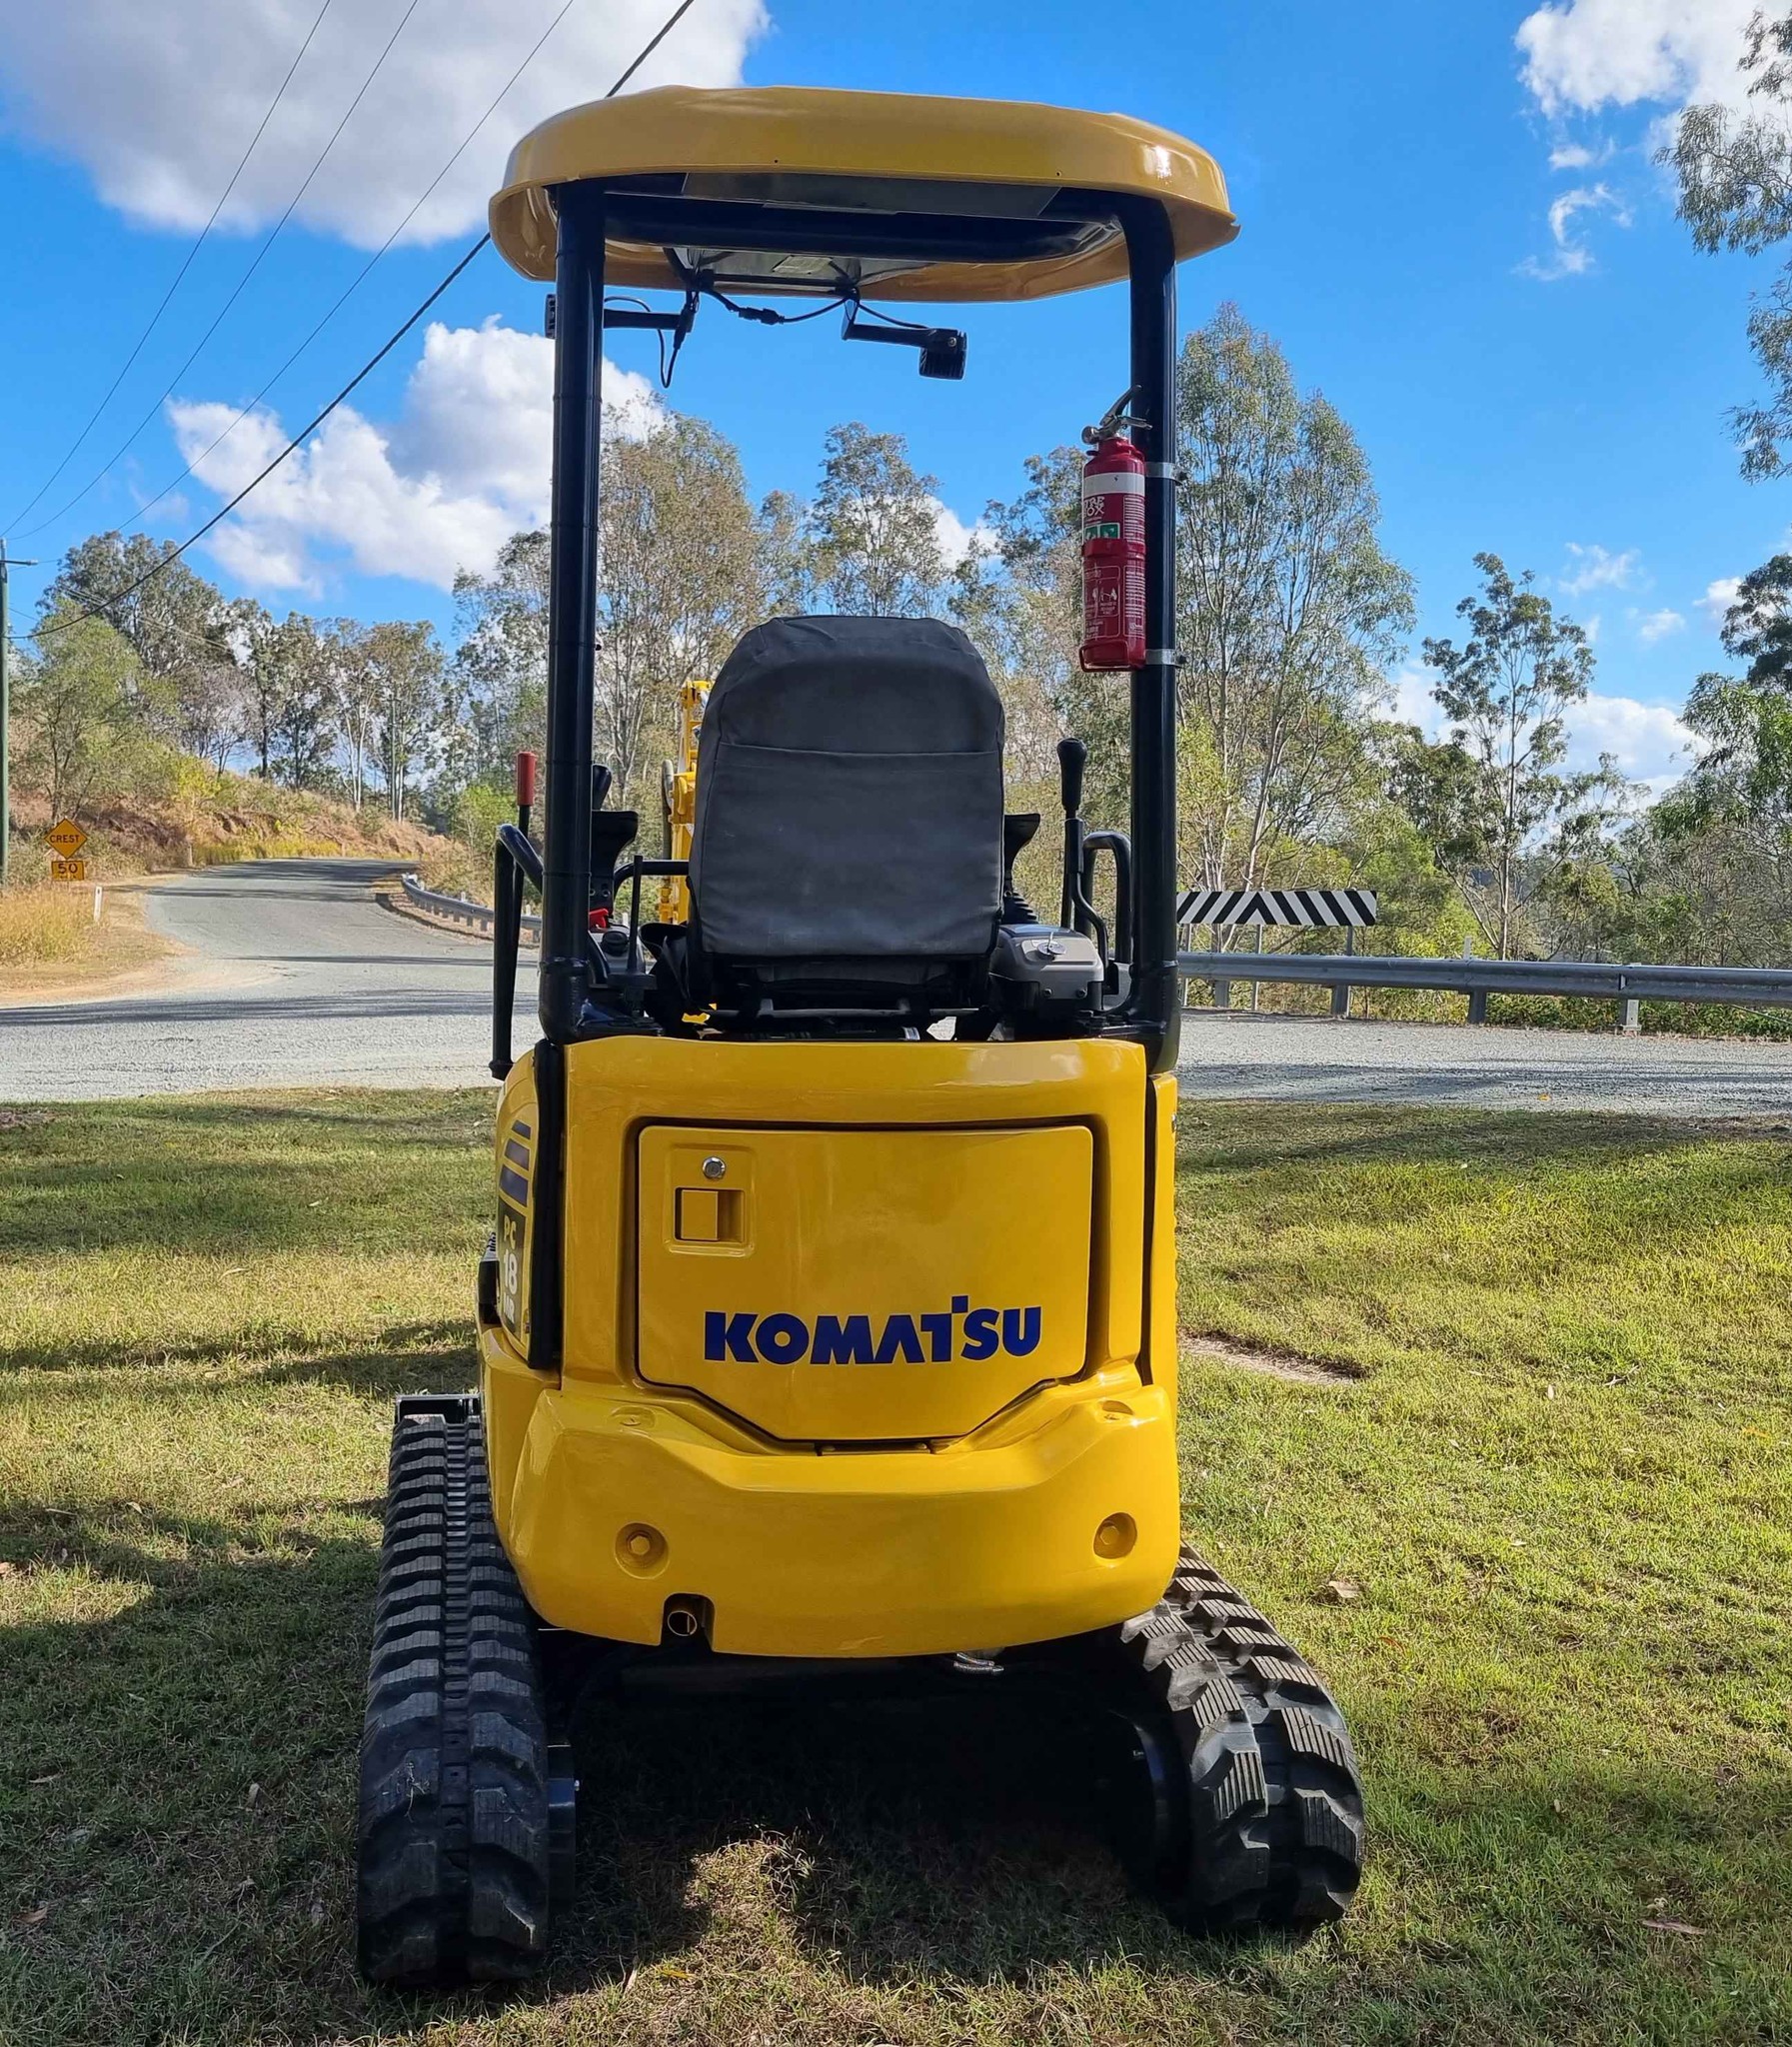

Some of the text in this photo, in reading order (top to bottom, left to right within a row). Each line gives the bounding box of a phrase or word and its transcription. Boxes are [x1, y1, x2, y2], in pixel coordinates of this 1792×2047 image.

[58, 863, 78, 874] 50
[504, 1214, 516, 1249] PC
[503, 1248, 518, 1295] 18
[704, 1295, 1041, 1365] KOMATSU
